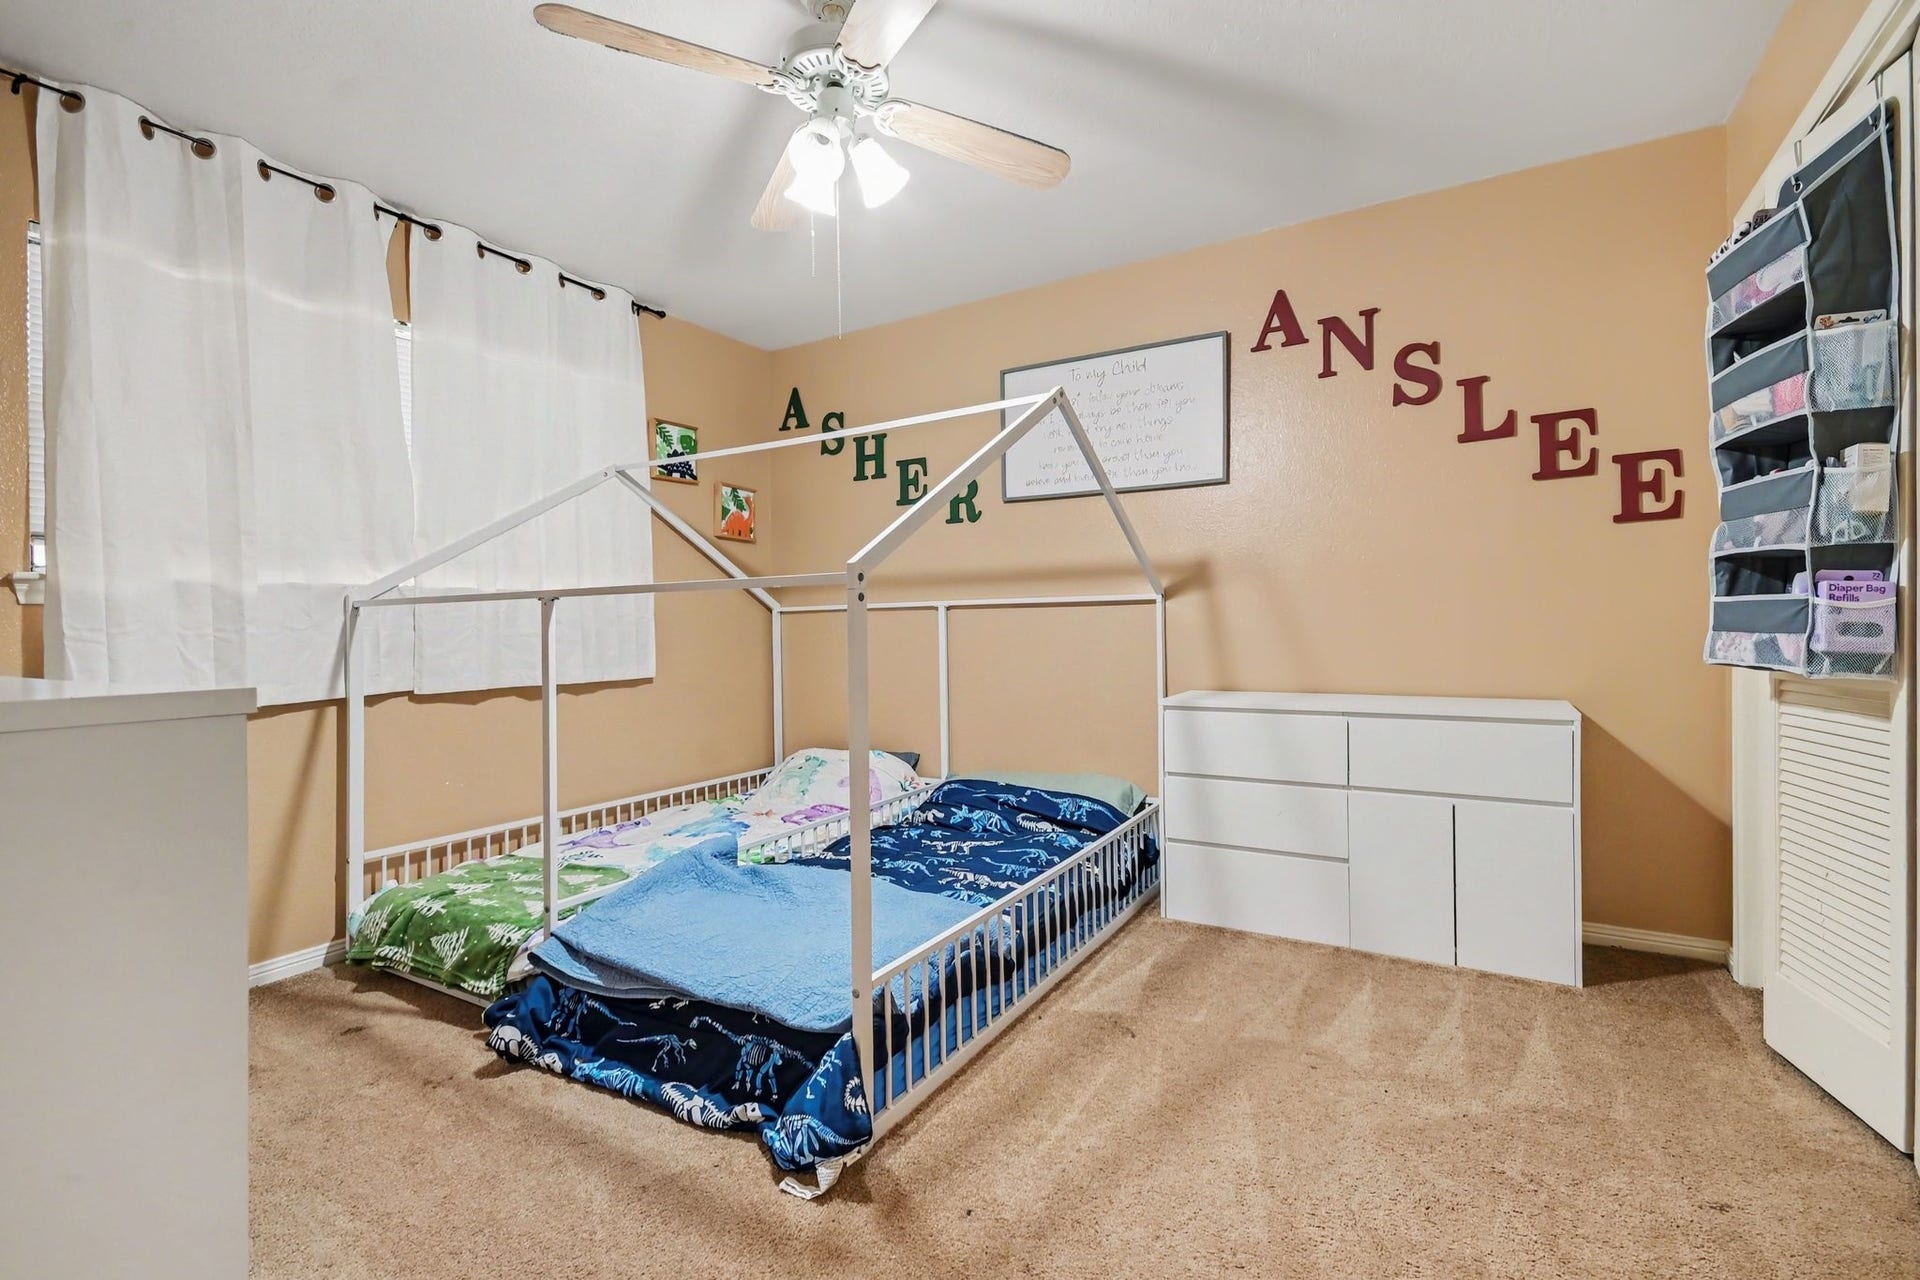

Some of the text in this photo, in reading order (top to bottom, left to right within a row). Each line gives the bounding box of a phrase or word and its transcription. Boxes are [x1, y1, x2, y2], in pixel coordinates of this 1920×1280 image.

[1070, 367, 1081, 382] To
[1112, 357, 1147, 376] Child
[1116, 388, 1141, 406] your
[1250, 289, 1684, 524] ANSLEE
[778, 386, 983, 525] ASHER
[1162, 447, 1184, 463] you
[1828, 583, 1886, 594] Diaper Bag
[1828, 593, 1860, 602] Refills
